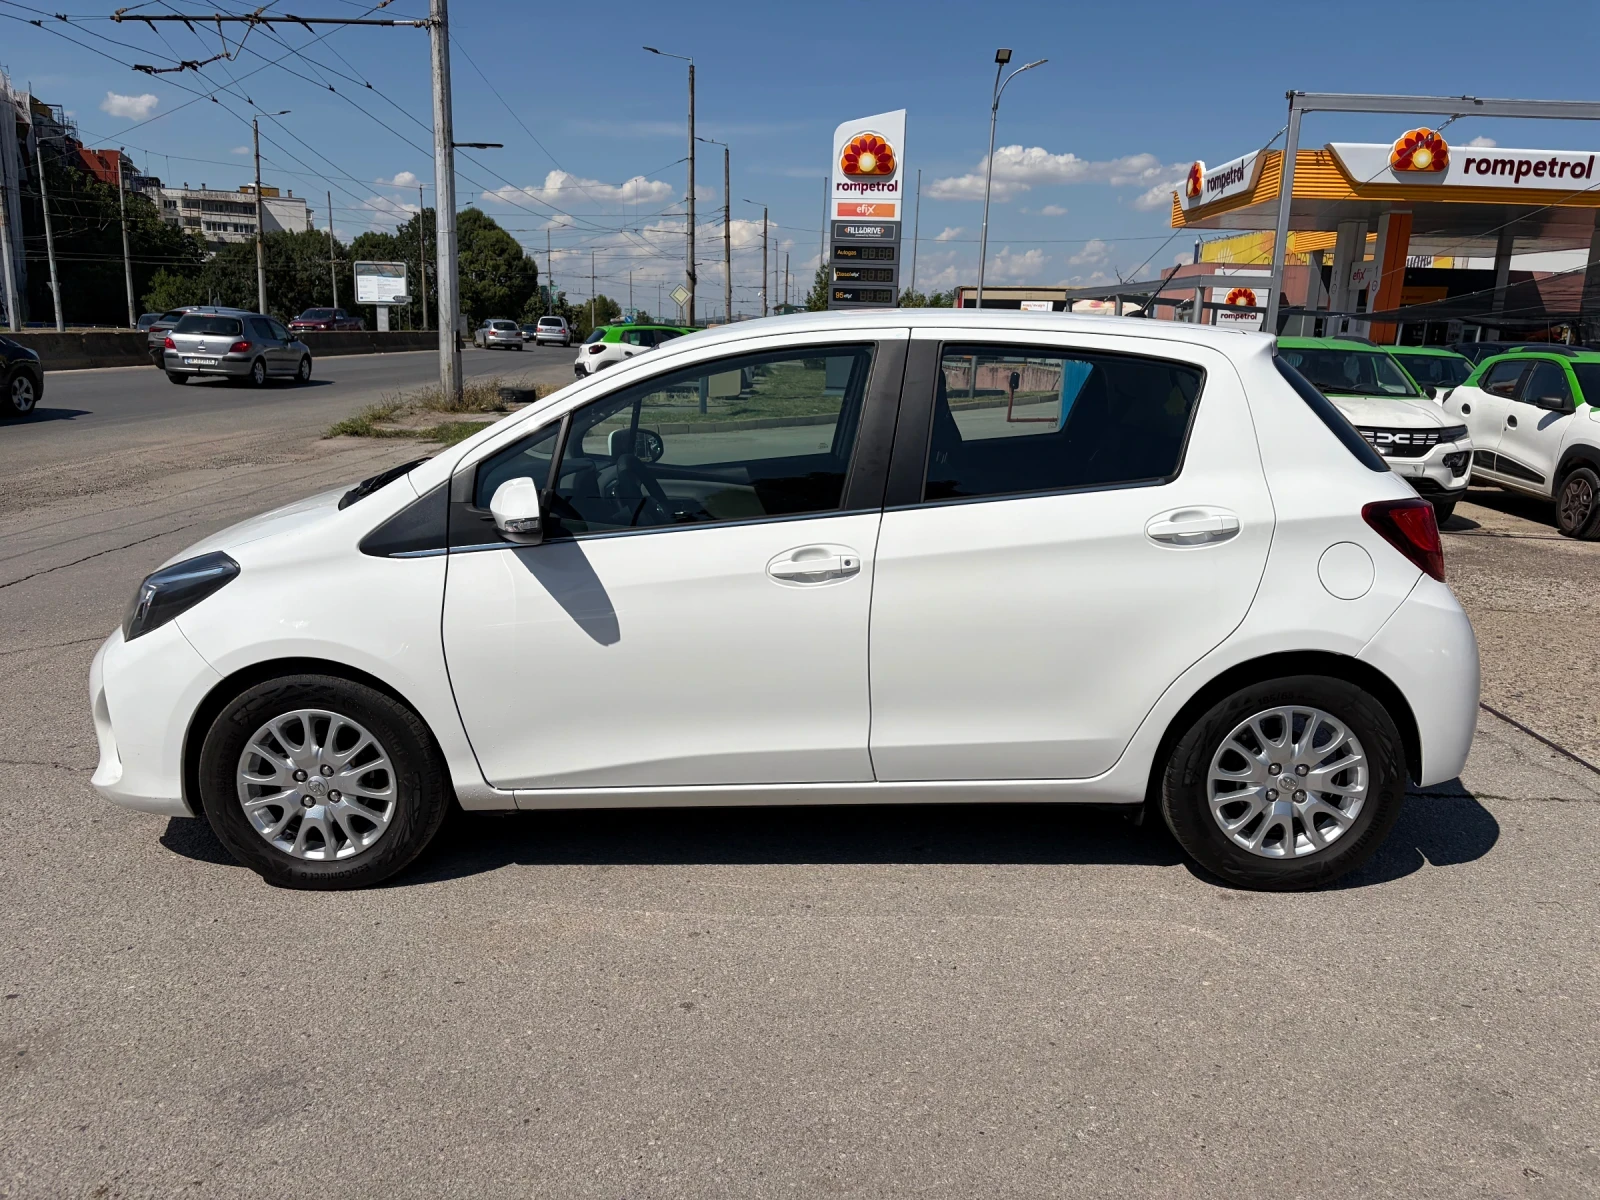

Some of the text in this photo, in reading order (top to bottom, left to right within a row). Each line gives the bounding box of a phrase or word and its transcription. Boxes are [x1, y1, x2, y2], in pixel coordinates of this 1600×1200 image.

[1463, 155, 1596, 184] rompetrol
[1206, 159, 1244, 194] rompetrol
[836, 180, 898, 195] rompetrol
[856, 204, 876, 215] efix
[847, 226, 881, 234] FILL&DRIVE
[835, 291, 844, 299] 95
[1220, 312, 1257, 321] rompetrol
[311, 863, 370, 881] EcoContact
